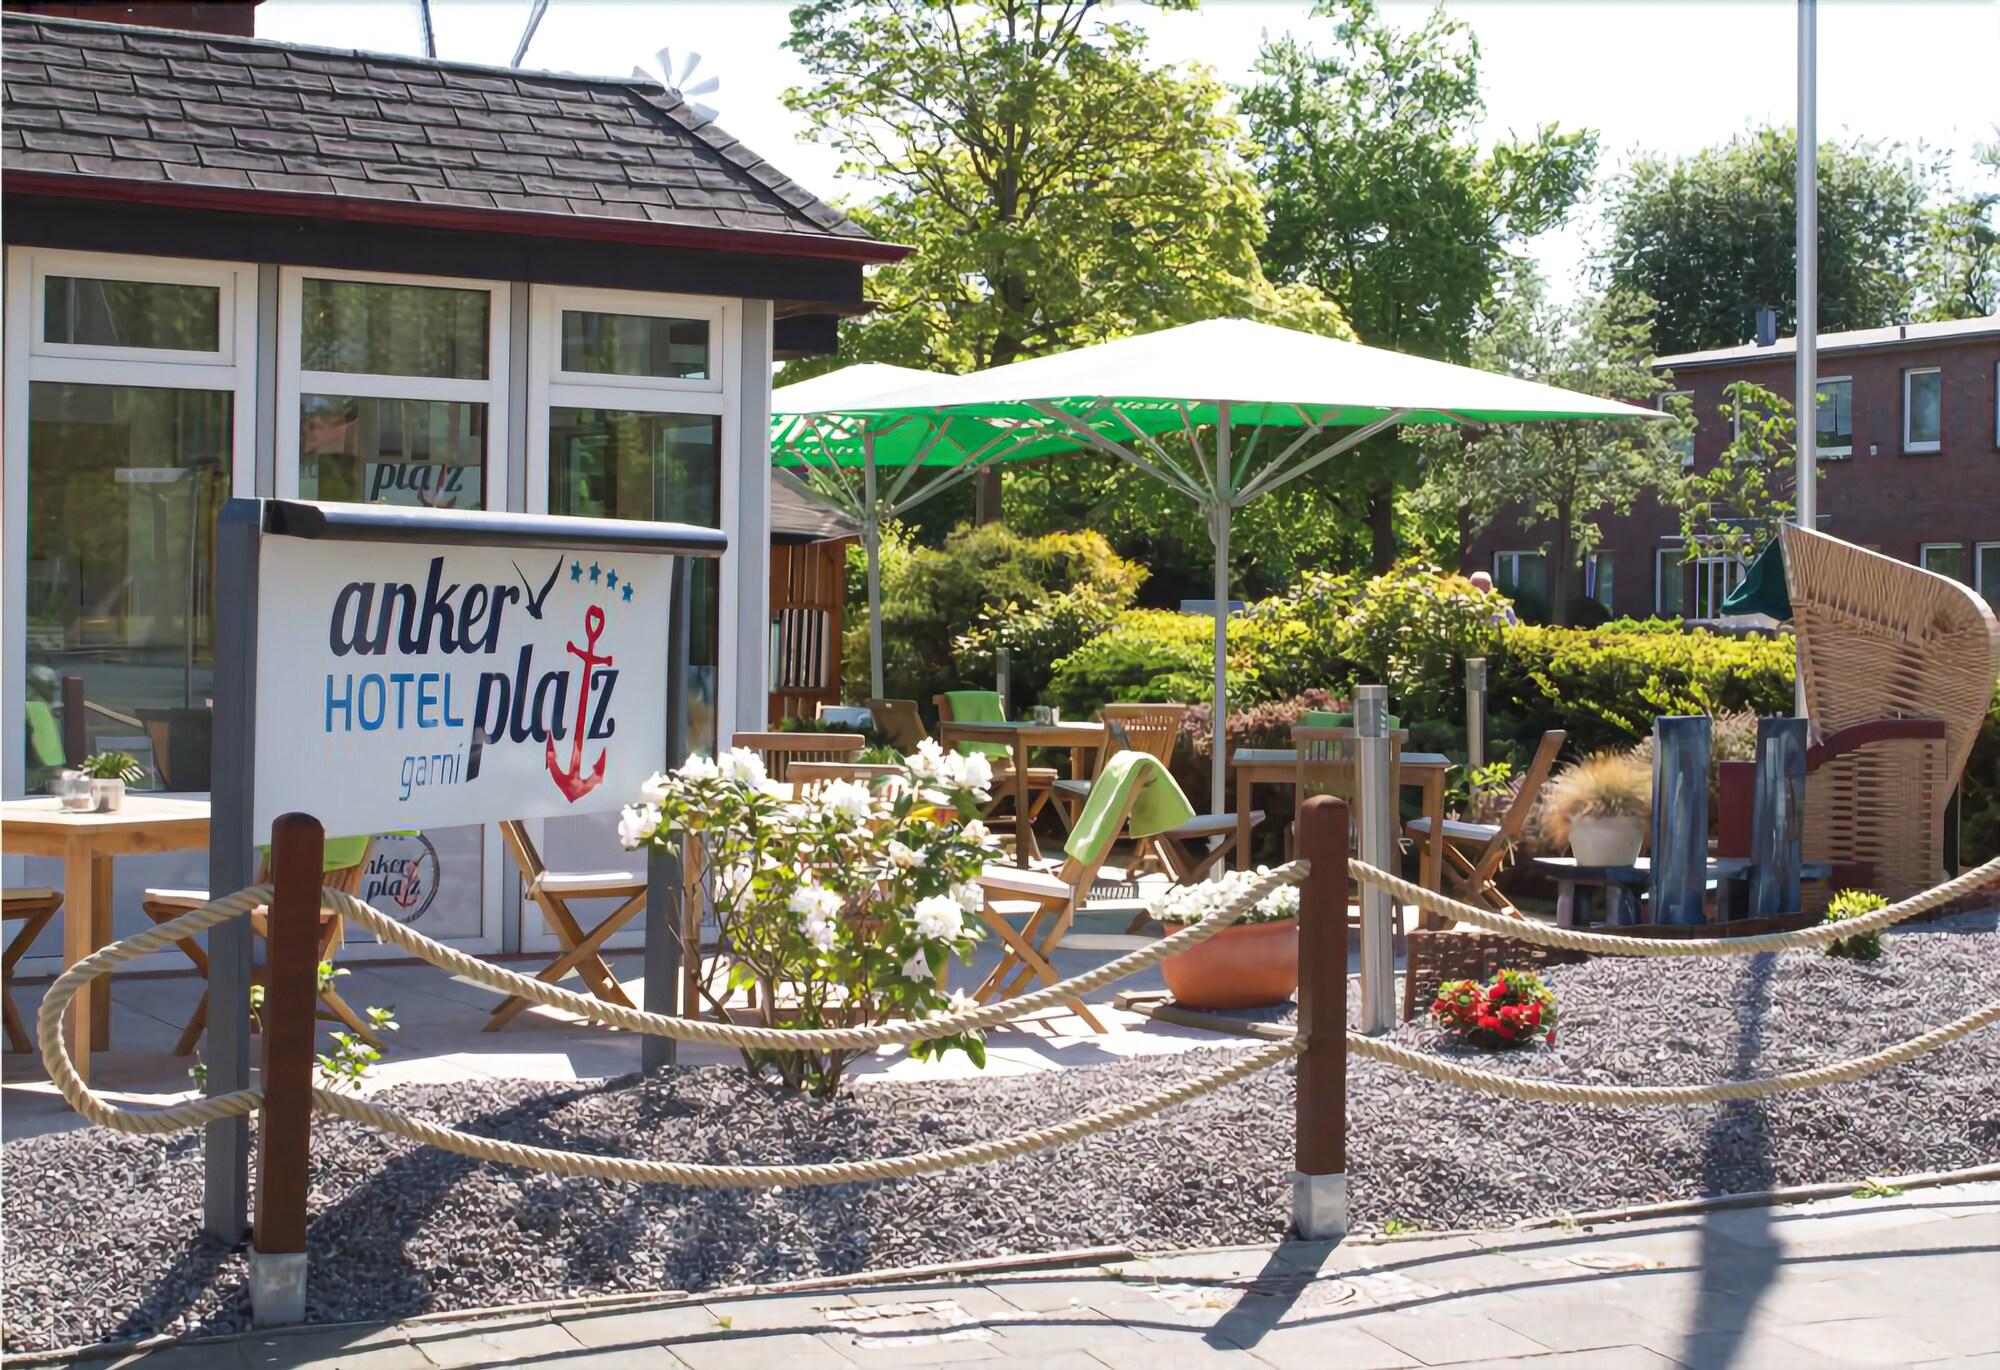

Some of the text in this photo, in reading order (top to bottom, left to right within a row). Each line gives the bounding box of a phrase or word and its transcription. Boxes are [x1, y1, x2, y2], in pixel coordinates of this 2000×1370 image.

[329, 556, 519, 657] anker
[325, 672, 464, 732] HOTEL
[399, 743, 463, 801] garni
[365, 854, 411, 875] nker
